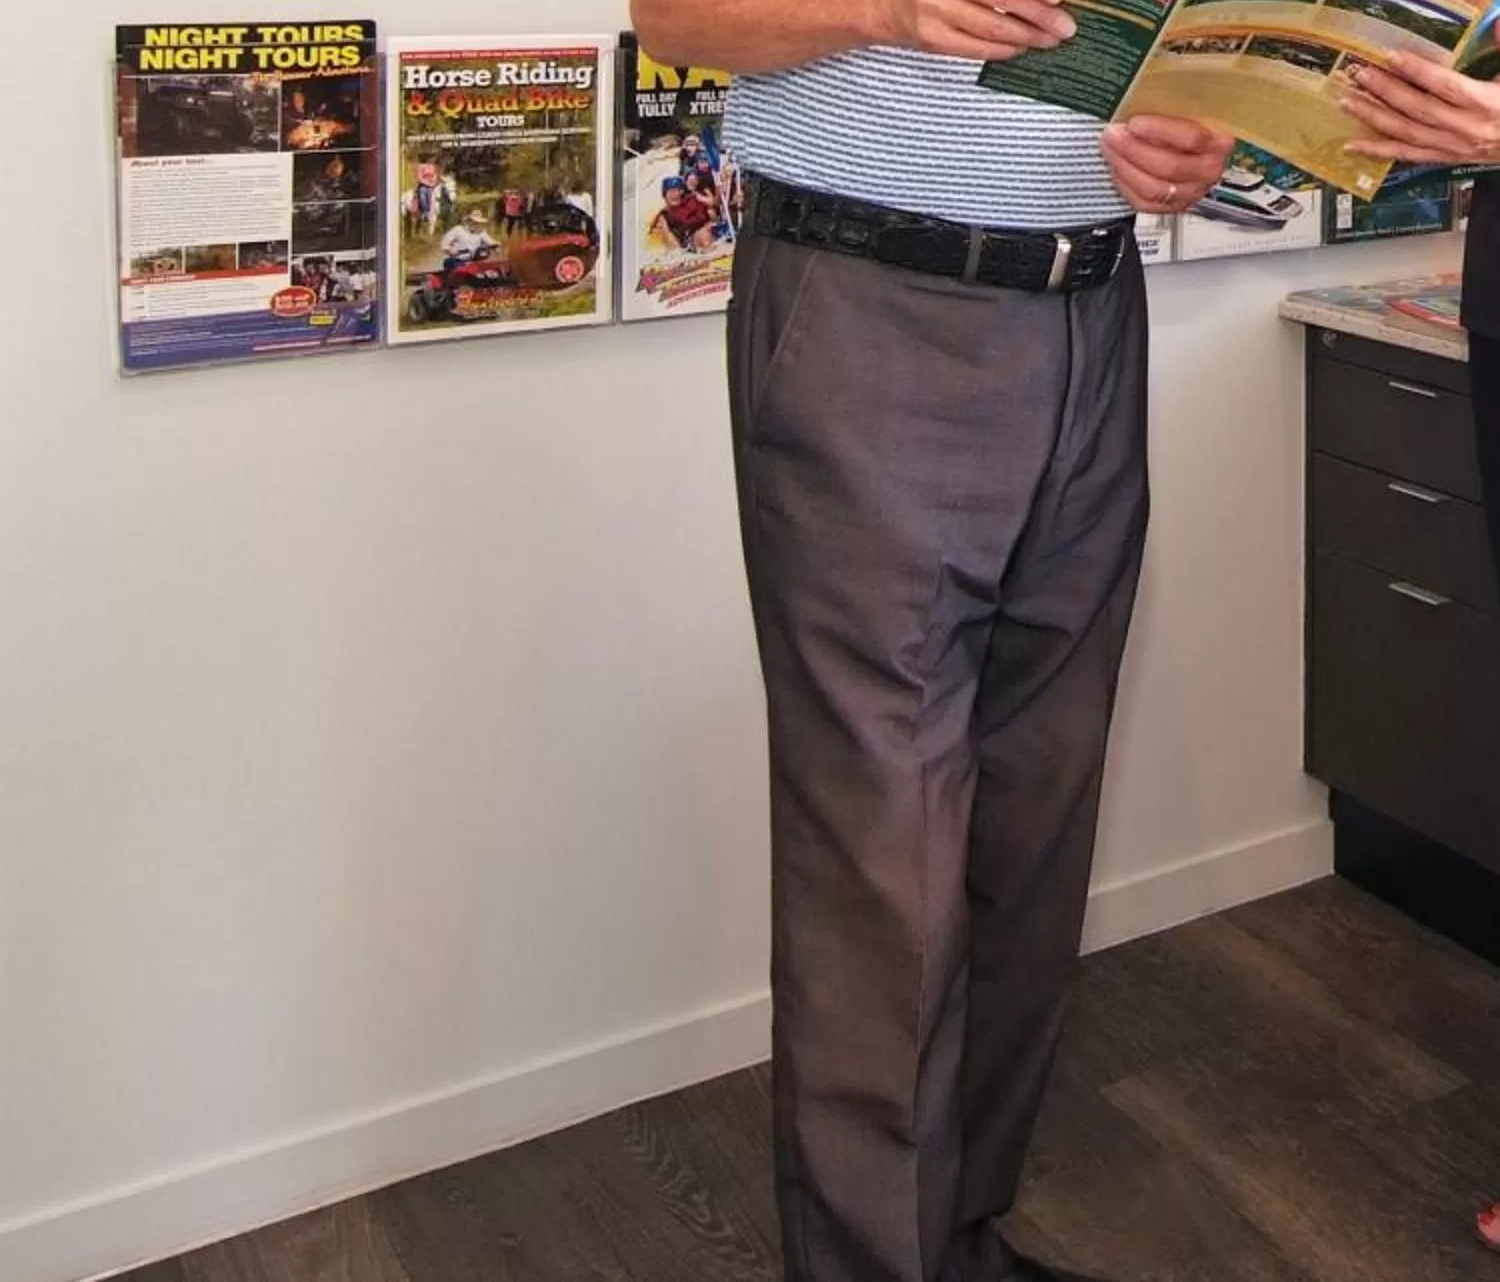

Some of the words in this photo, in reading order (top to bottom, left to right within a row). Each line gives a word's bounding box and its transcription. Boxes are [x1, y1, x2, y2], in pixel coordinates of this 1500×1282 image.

[145, 28, 248, 47] NIGHT
[258, 25, 364, 45] TOURS
[140, 49, 243, 70] NIGHT
[252, 46, 361, 68] TOURS
[404, 65, 491, 89] Horse
[497, 61, 594, 89] Riding
[407, 94, 432, 115] &
[439, 90, 519, 118] Quad
[526, 87, 590, 112] Bike
[638, 104, 675, 117] TULLY
[689, 102, 728, 115] XTRE
[476, 115, 525, 128] TOURS
